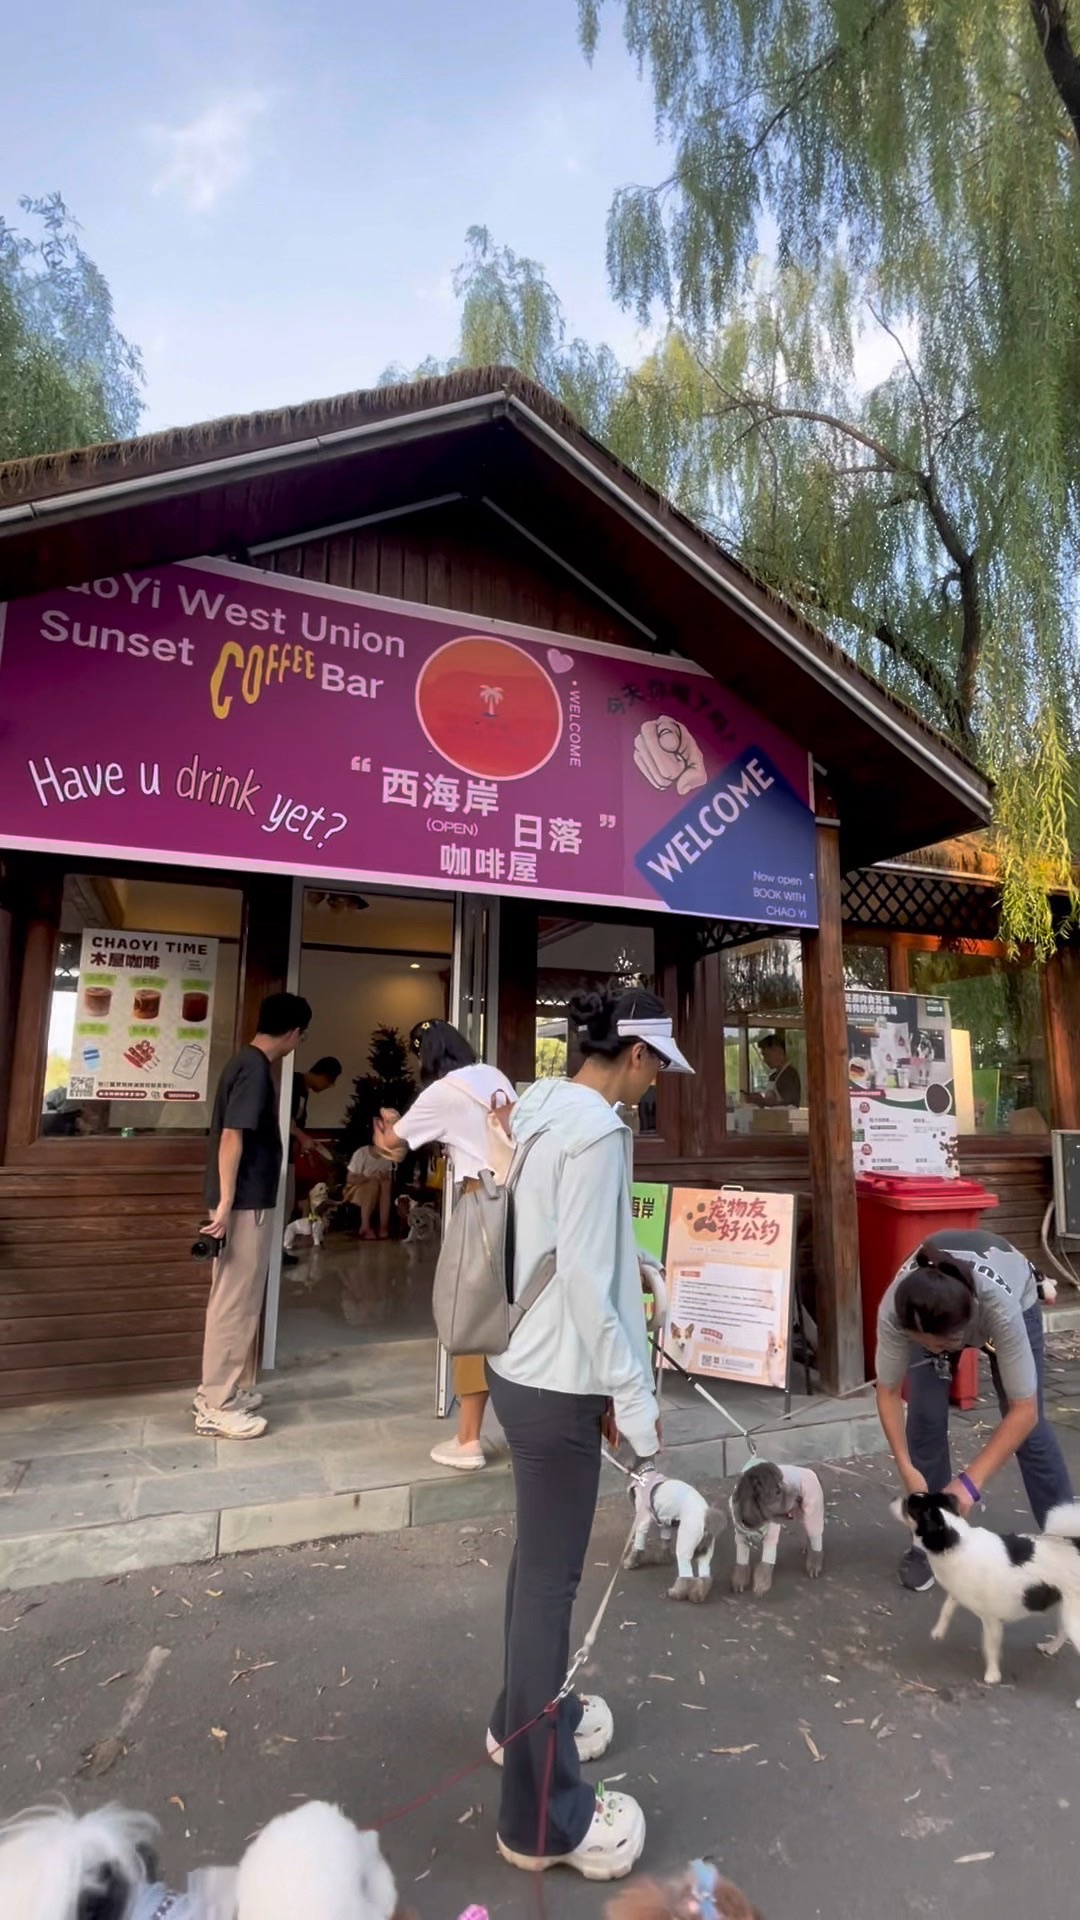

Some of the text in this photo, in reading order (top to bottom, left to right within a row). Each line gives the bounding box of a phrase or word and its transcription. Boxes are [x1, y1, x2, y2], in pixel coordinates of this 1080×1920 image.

[178, 584, 287, 635] West
[301, 611, 406, 658] Union
[40, 609, 384, 719] Sunset COFFEE Bar
[568, 689, 582, 768] WELCOME
[28, 754, 348, 849] Have u drink yet?
[426, 817, 479, 837] (OPEN)
[646, 758, 775, 882] WELCOME
[440, 843, 538, 884] 咖啡屋
[753, 871, 802, 886] Now open
[753, 887, 806, 902] BOOK WITH
[766, 905, 807, 919] CHAO YI
[92, 937, 208, 955] CHAOYI TIME
[90, 952, 160, 970] 木屋咖啡
[708, 1196, 768, 1223] 宠物友
[717, 1219, 781, 1246] 好公约
